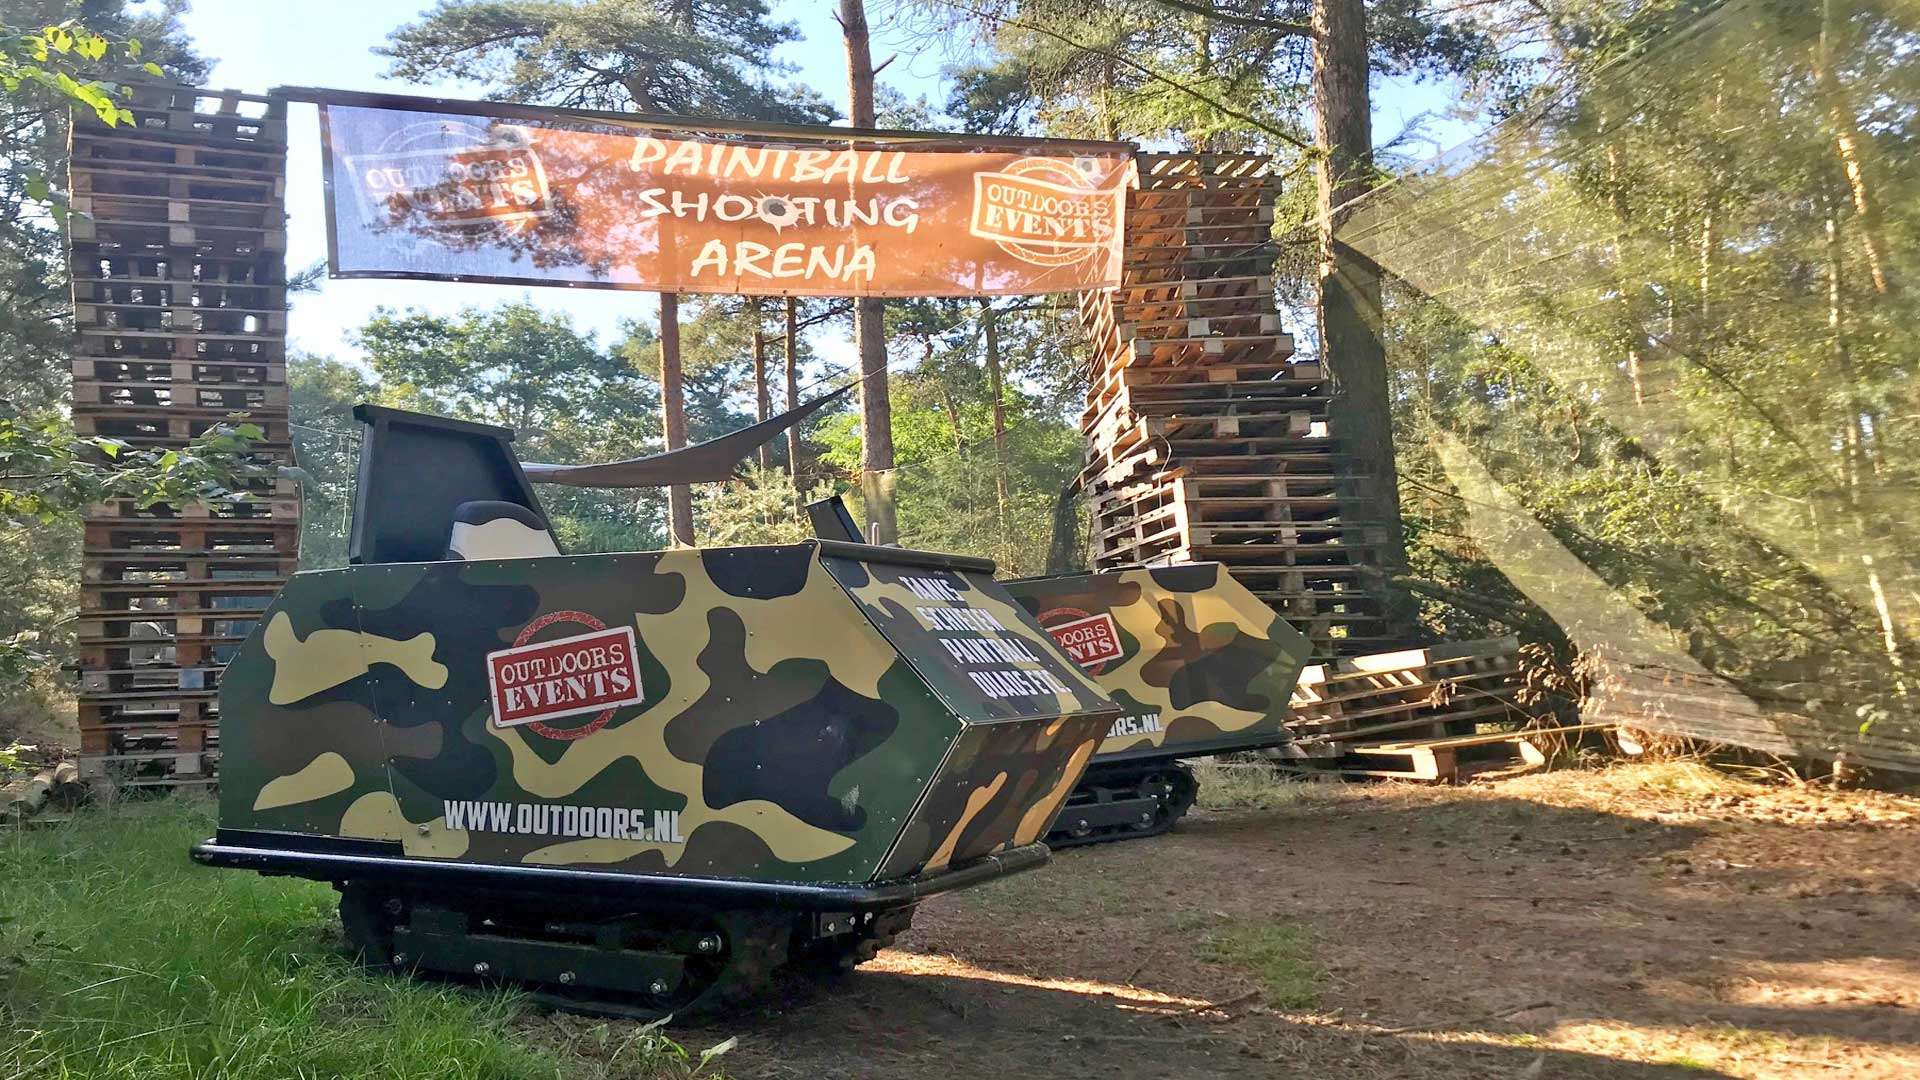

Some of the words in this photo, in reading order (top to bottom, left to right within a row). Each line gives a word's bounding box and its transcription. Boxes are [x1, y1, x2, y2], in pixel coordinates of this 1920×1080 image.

[629, 137, 910, 184] PAINTBALL
[987, 183, 1110, 217] OUTDOORS
[984, 203, 1114, 239] EVENTS
[690, 238, 877, 282] ARENA
[898, 575, 965, 602] TANKS
[915, 606, 1007, 632] SCHIETEN
[1053, 623, 1108, 647] OORS
[500, 643, 625, 686] OUTDOORS
[939, 638, 1041, 664] PAINTBALL
[503, 666, 631, 713] EVENTS
[967, 670, 1039, 700] QUADS
[1022, 668, 1073, 695] ETC.
[444, 800, 684, 844] WWW.OUTDOORS.NL
